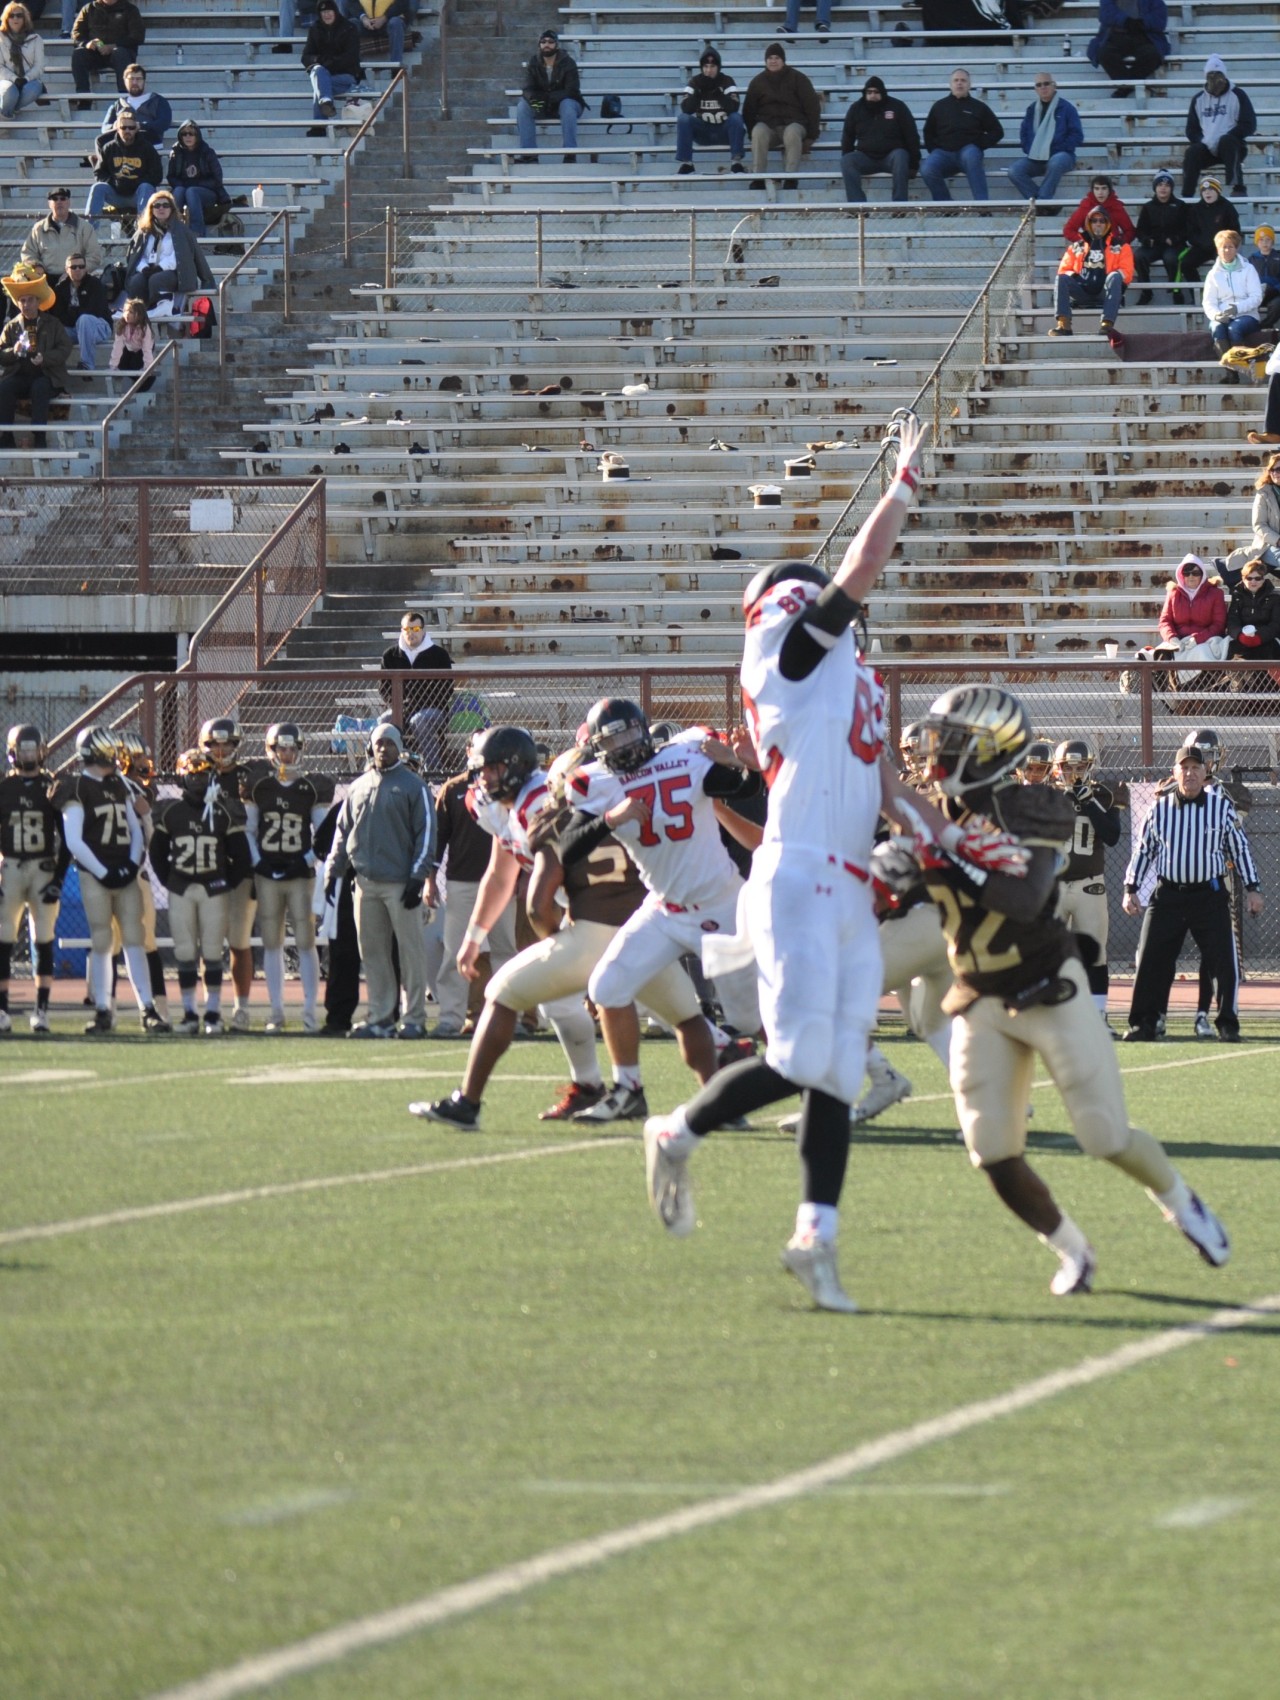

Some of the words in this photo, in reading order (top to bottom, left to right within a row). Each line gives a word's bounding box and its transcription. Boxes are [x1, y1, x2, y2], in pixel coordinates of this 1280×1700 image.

[655, 759, 689, 772] VALLEY
[94, 803, 131, 845] 75
[626, 774, 694, 847] 75
[9, 811, 45, 852] 18
[261, 811, 303, 852] 28
[174, 835, 218, 875] 20
